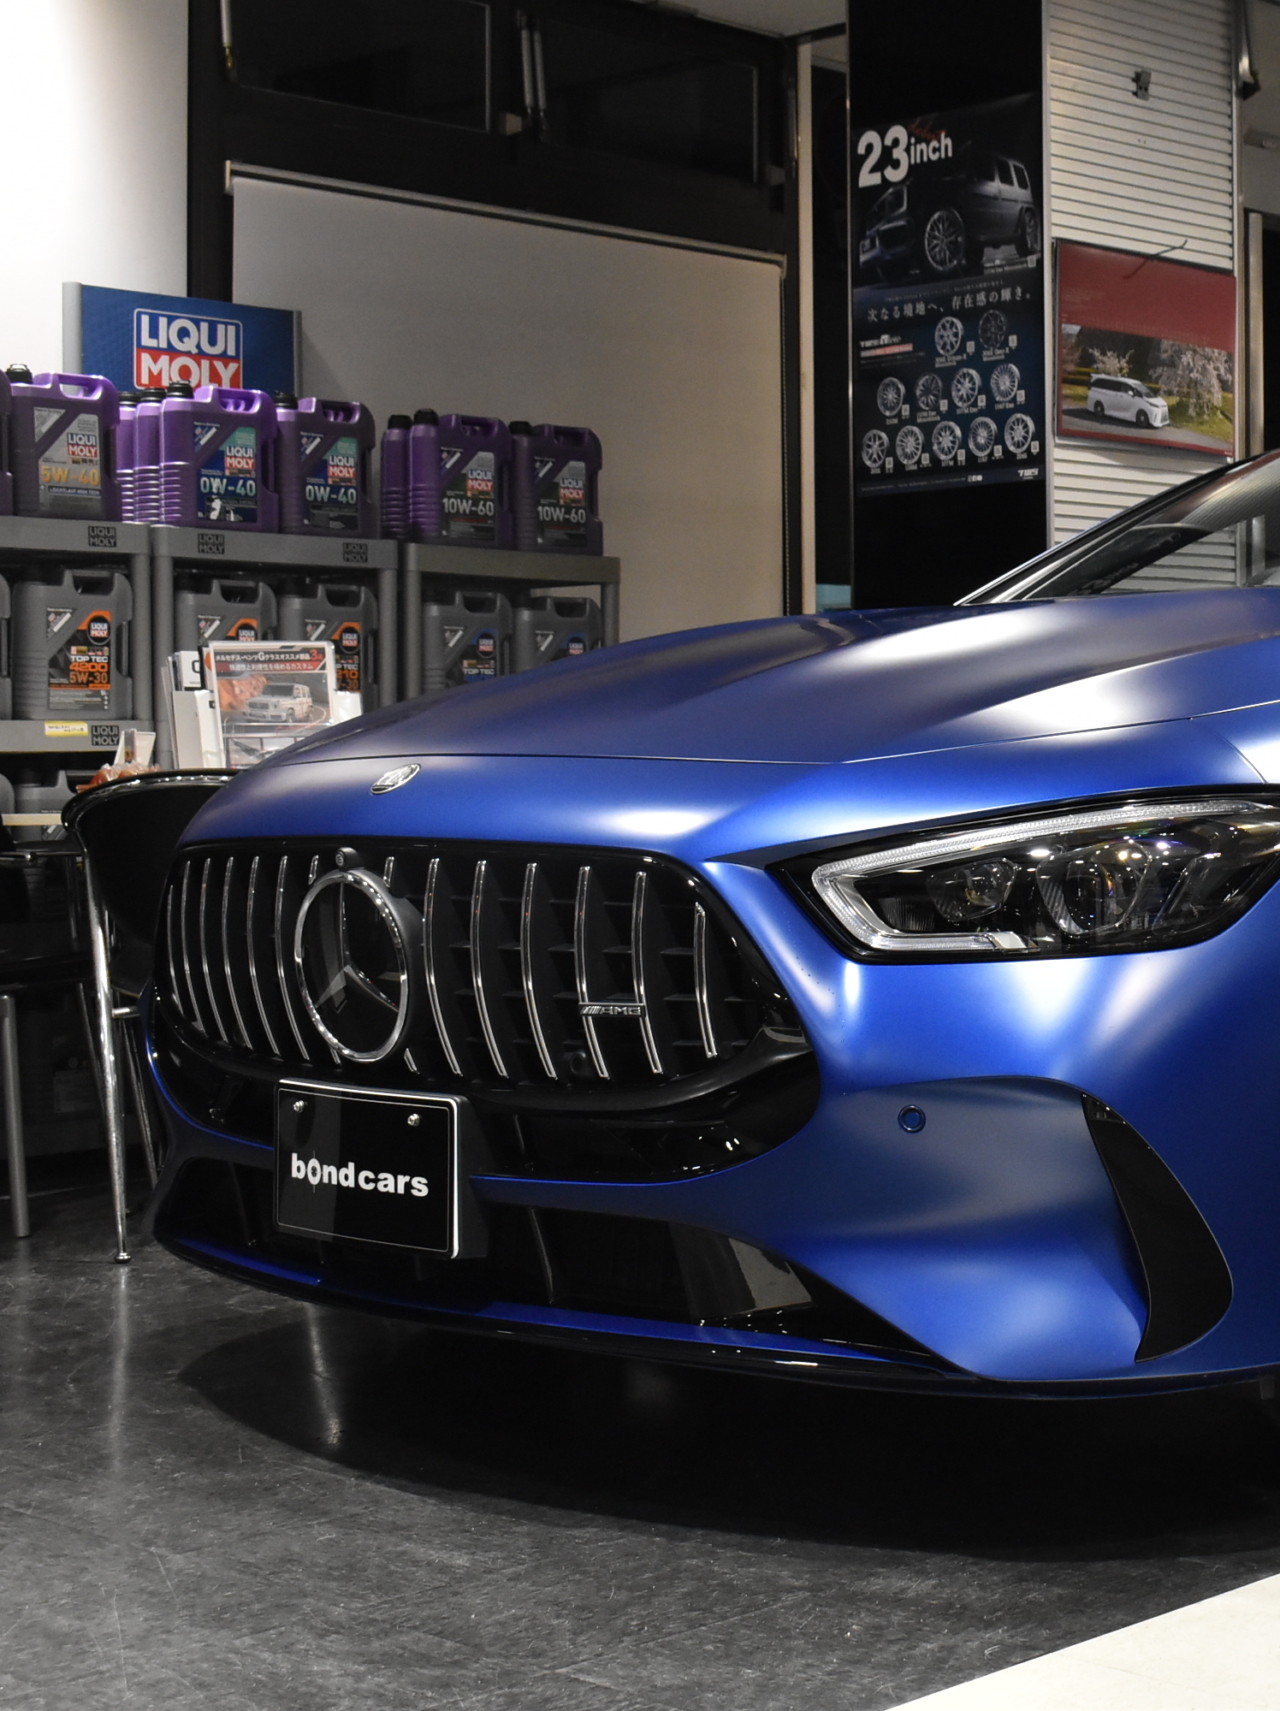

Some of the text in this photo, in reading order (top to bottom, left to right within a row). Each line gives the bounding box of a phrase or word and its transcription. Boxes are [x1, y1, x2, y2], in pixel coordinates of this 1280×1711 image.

[141, 314, 236, 357] LIQUI
[141, 352, 239, 389] MOLY
[68, 433, 97, 446] LIQUI
[68, 446, 98, 458] MOLY
[226, 446, 254, 457] LIQUI
[226, 457, 255, 469] MOLY
[328, 455, 354, 467] LIQUI
[41, 465, 100, 486] 5W-40
[328, 467, 356, 477] MOLY
[468, 469, 493, 480] LIQUI
[200, 476, 257, 497] 0W-40
[468, 480, 493, 491] MOLY
[560, 478, 583, 488] LIQUI
[305, 485, 357, 505] 0W-40
[560, 488, 585, 499] MOLY
[442, 497, 495, 517] 10W-60
[537, 505, 587, 524] 10W-60
[89, 527, 116, 537] LIQUI
[89, 537, 117, 546] MOLY
[91, 622, 108, 630] LIQUI
[69, 662, 109, 672] 4200
[69, 672, 108, 684] 5W-30
[336, 669, 359, 680] 210
[92, 726, 119, 735] LIQUI
[92, 736, 119, 745] MOLY
[600, 1006, 641, 1015] AMG
